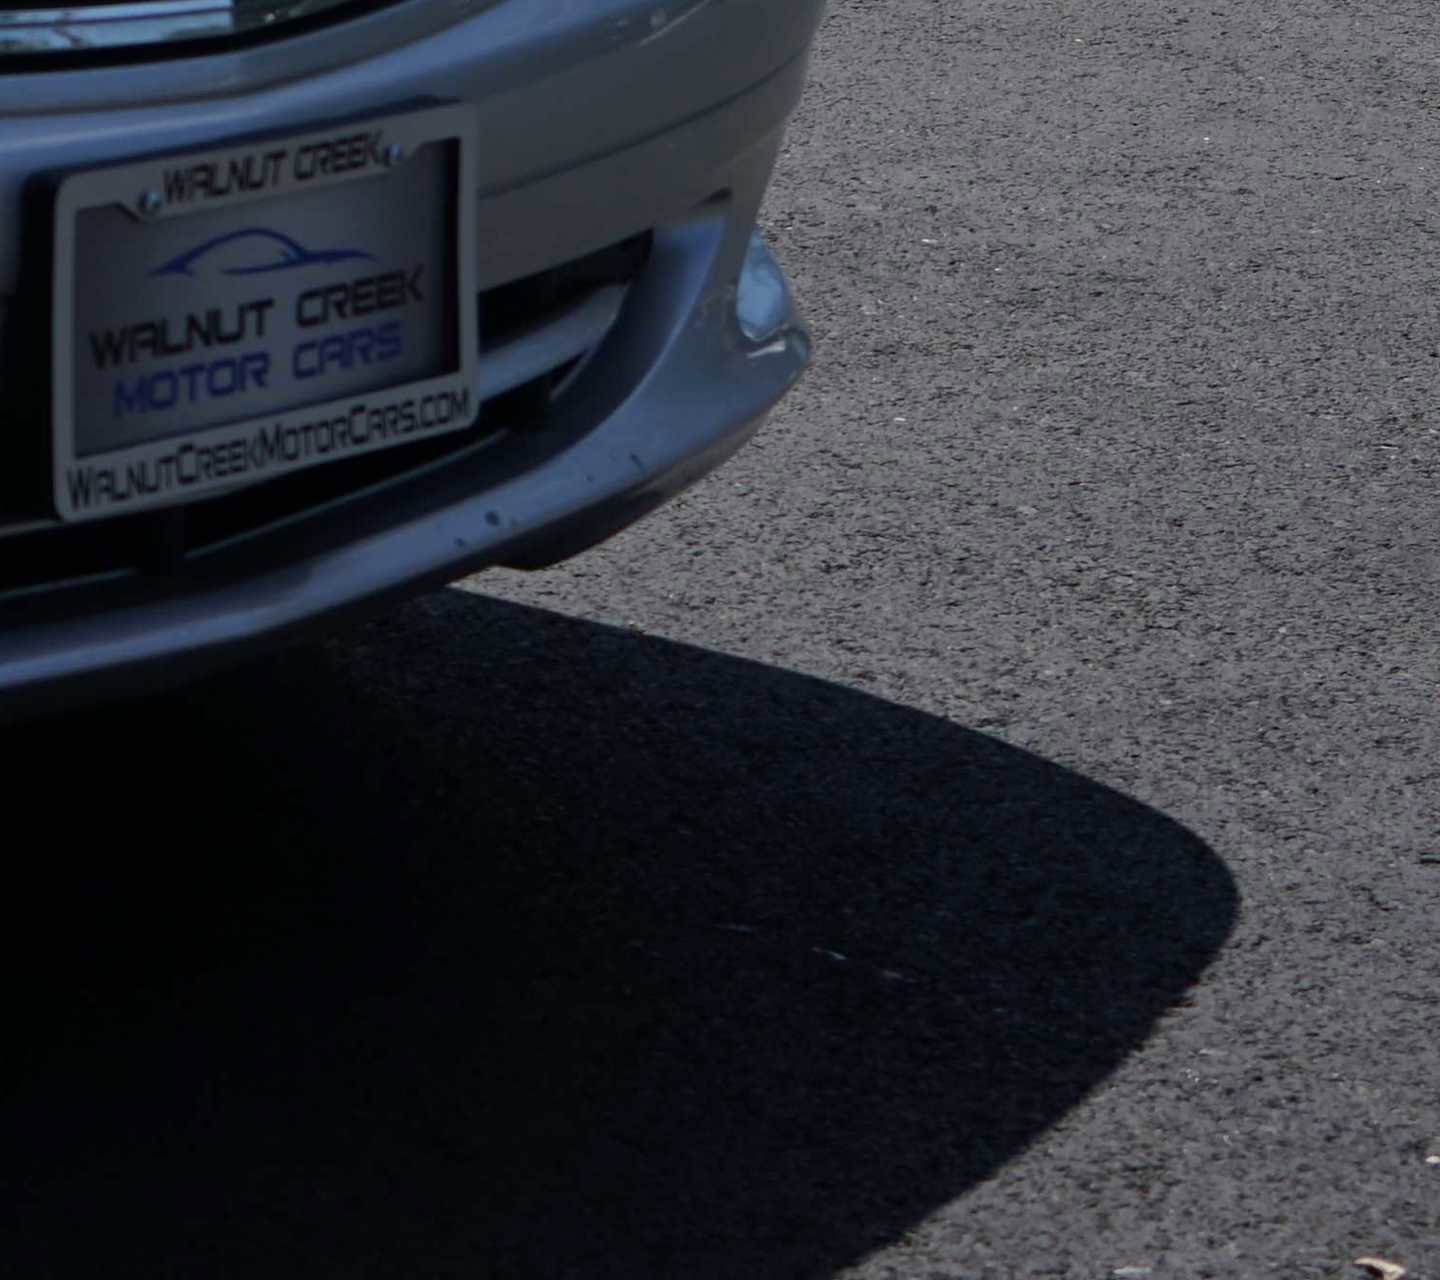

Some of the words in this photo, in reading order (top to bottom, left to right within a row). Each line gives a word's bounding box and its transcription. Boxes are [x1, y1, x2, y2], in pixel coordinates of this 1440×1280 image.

[163, 148, 287, 205] WALNUT
[293, 129, 391, 181] CREEK
[88, 298, 274, 370] WALNUT
[295, 264, 424, 329] CREEK
[113, 350, 270, 418] MOTOR
[292, 320, 403, 380] CARS
